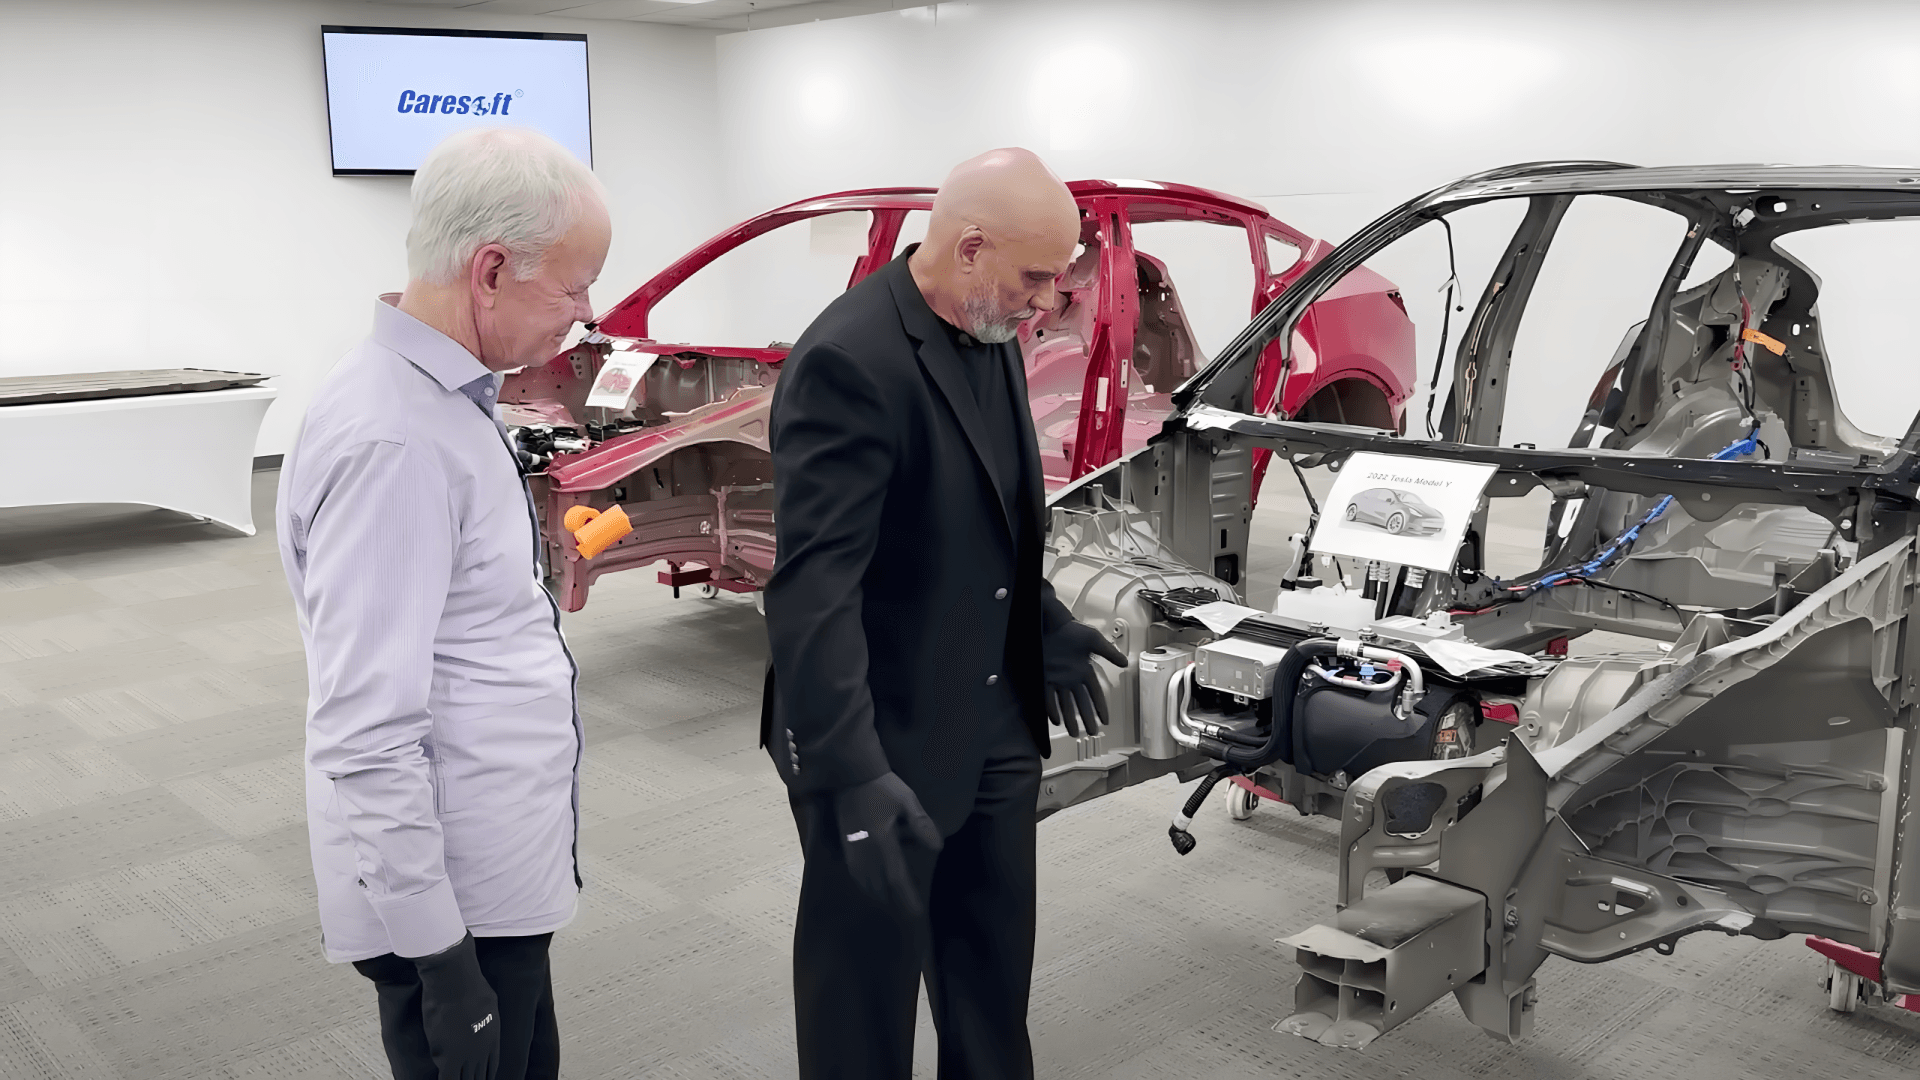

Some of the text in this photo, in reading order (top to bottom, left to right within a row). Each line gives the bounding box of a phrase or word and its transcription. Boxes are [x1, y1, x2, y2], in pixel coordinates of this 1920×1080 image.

[1366, 472, 1453, 488] 2022 Tesla Model Y
